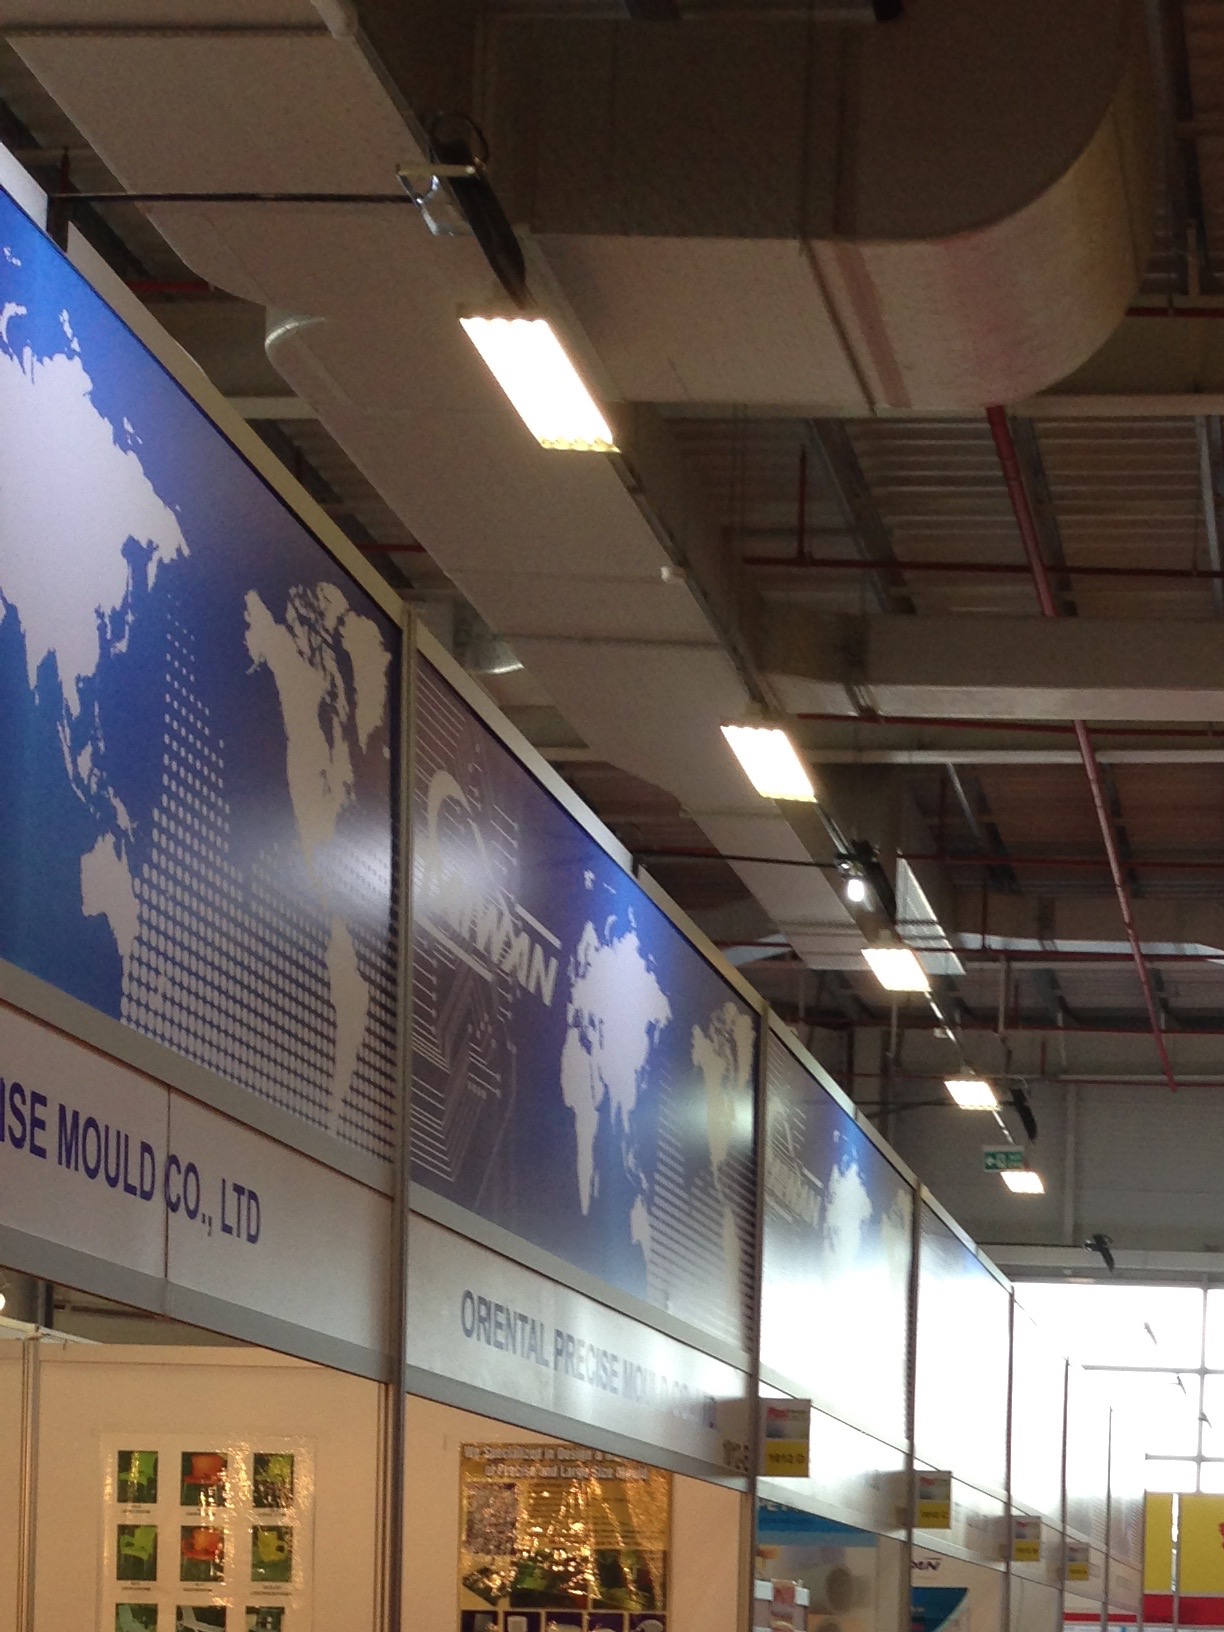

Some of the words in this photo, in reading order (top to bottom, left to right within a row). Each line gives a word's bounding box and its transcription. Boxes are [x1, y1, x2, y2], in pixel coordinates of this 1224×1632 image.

[58, 1103, 156, 1201] MOULD
[164, 1154, 213, 1237] CO.,
[221, 1178, 261, 1244] LTD
[461, 1290, 550, 1369] ORIENTAL
[554, 1328, 620, 1395] PRECISE
